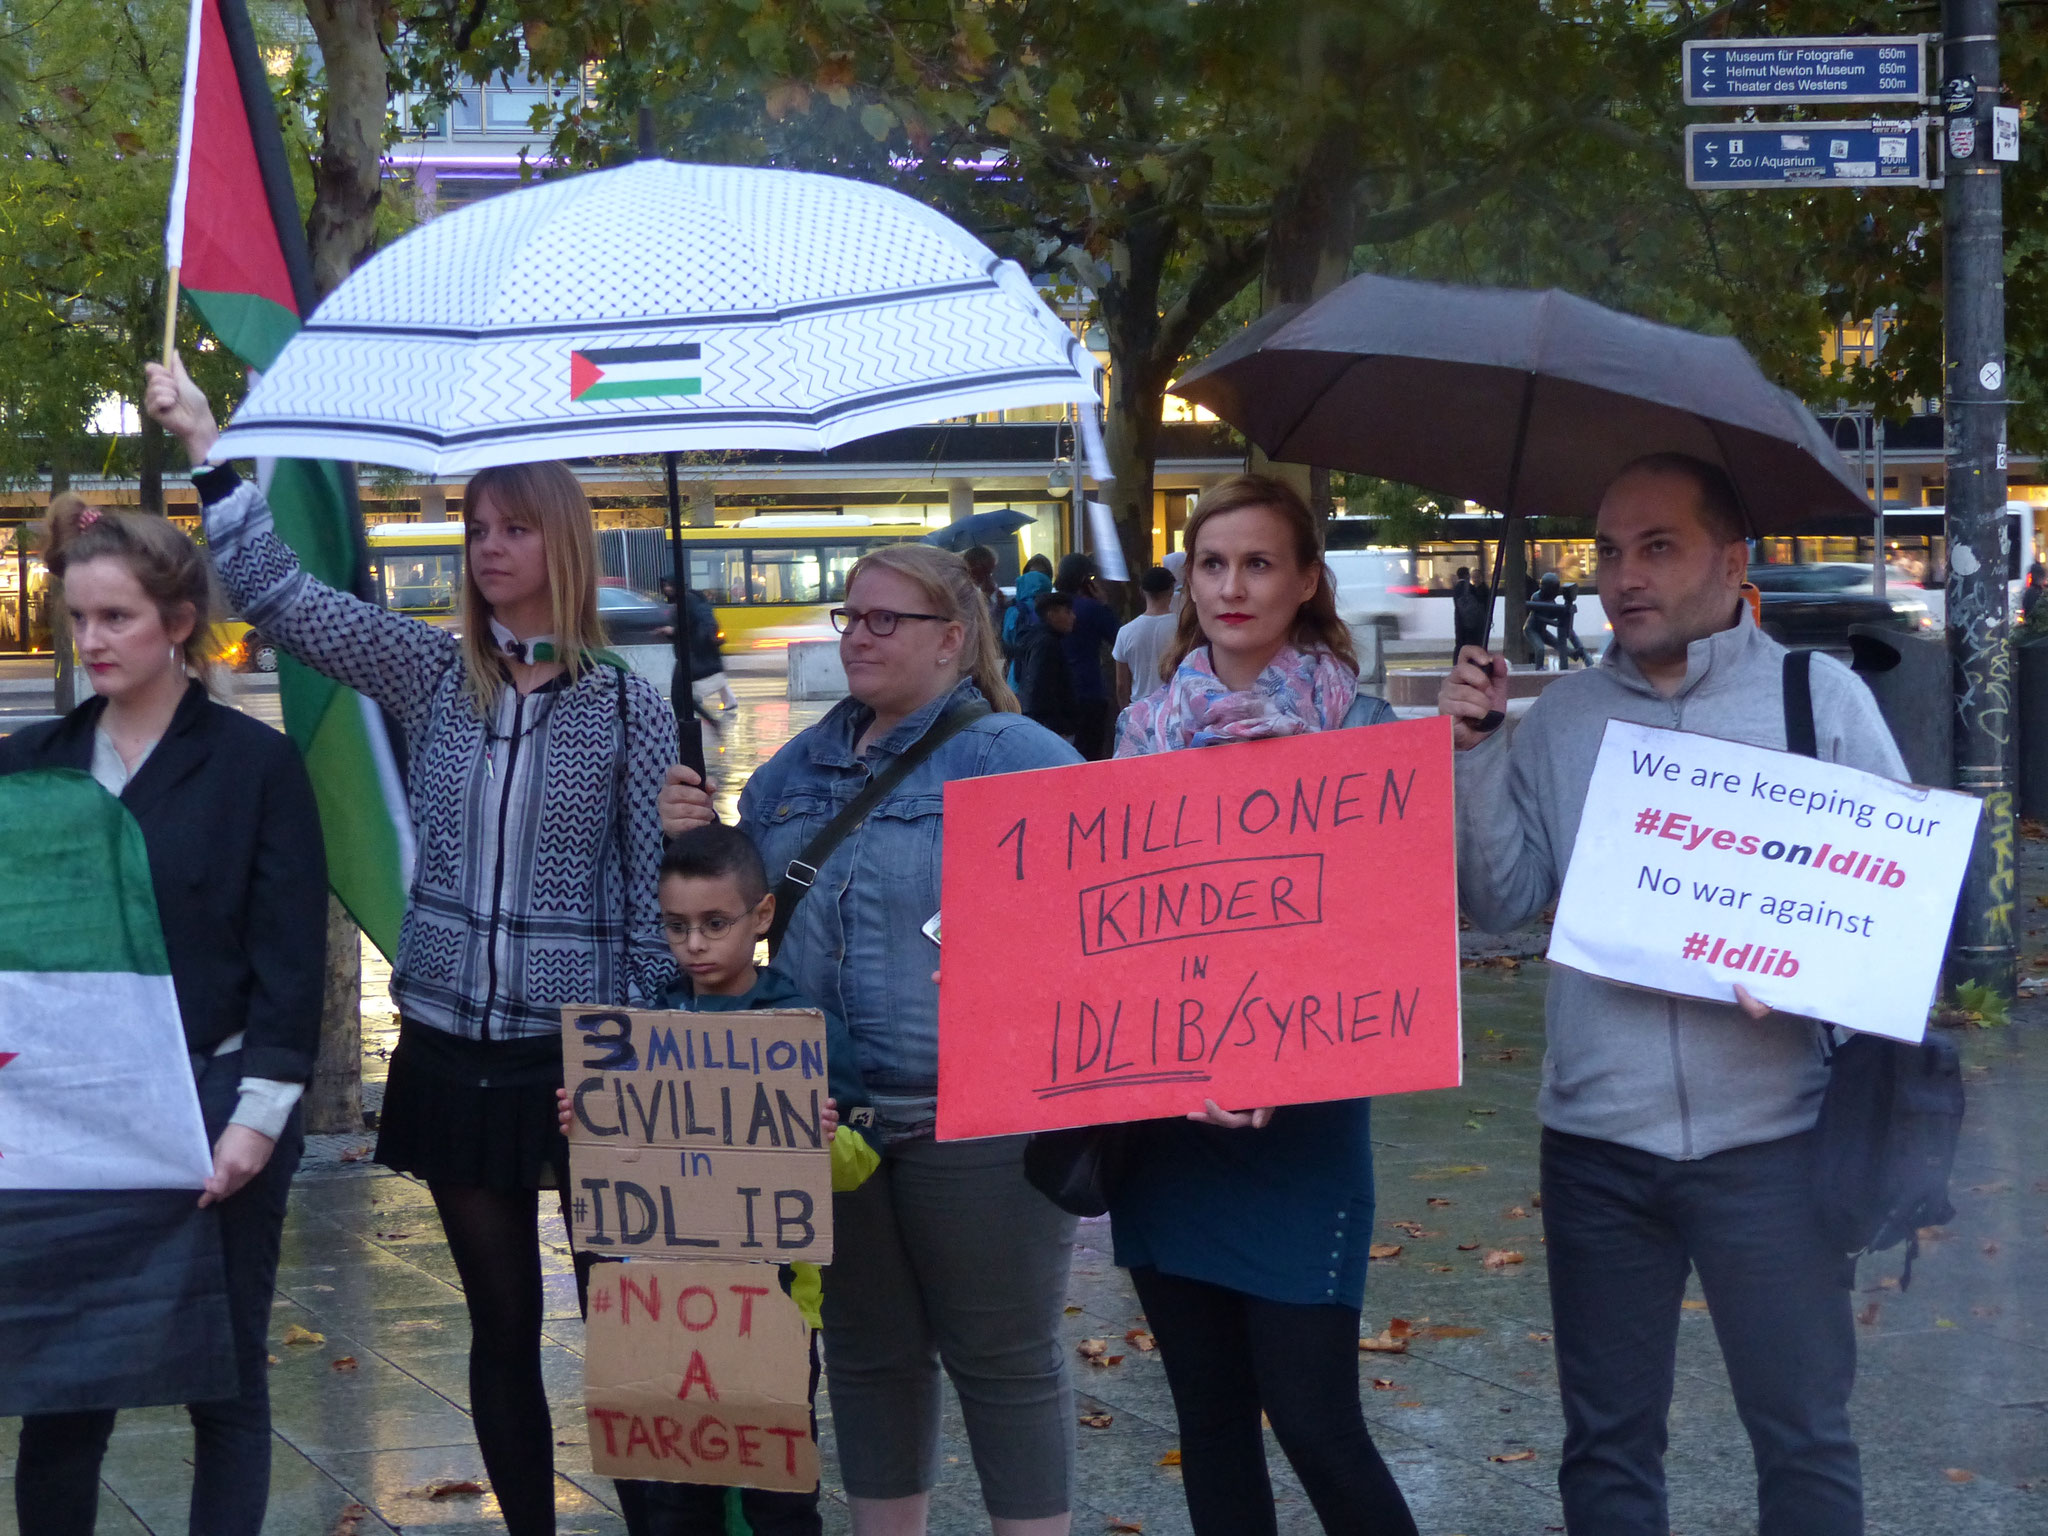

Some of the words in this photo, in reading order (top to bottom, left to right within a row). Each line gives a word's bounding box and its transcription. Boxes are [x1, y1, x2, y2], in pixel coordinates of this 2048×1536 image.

[1726, 51, 1775, 62] Museum
[1778, 50, 1794, 61] für
[1797, 49, 1854, 63] Fotografie
[1879, 48, 1906, 59] 650m
[1726, 65, 1767, 77] Helmut
[1769, 65, 1813, 77] Newton
[1816, 64, 1865, 76] Museum
[1879, 63, 1906, 74] 650m
[1726, 80, 1771, 92] Theater
[1774, 80, 1795, 91] des
[1798, 79, 1848, 91] Westens
[1879, 78, 1906, 89] 500m
[1729, 156, 1752, 168] Zoo
[1754, 156, 1760, 168] /
[1760, 156, 1815, 169] Aquarium
[998, 817, 1027, 880] 1
[1066, 768, 1417, 871] MILLIONEN
[1632, 750, 1681, 782] We
[1691, 768, 1741, 793] are
[1751, 772, 1875, 829] keeping
[1884, 810, 1940, 837] our
[1634, 807, 1906, 889] #EyesonIdlib
[1097, 876, 1306, 947] KINDER
[1637, 865, 1682, 896] No
[1692, 881, 1752, 911] war
[1759, 895, 1874, 938] against
[1181, 955, 1209, 982] IN
[1681, 931, 1801, 979] #Idlib
[574, 1013, 640, 1071] 3
[646, 1025, 824, 1079] MILLION
[573, 1077, 822, 1148] CIVILIAN
[592, 1273, 769, 1338] #NOT
[677, 1349, 719, 1402] A
[587, 1408, 806, 1476] TARGET
